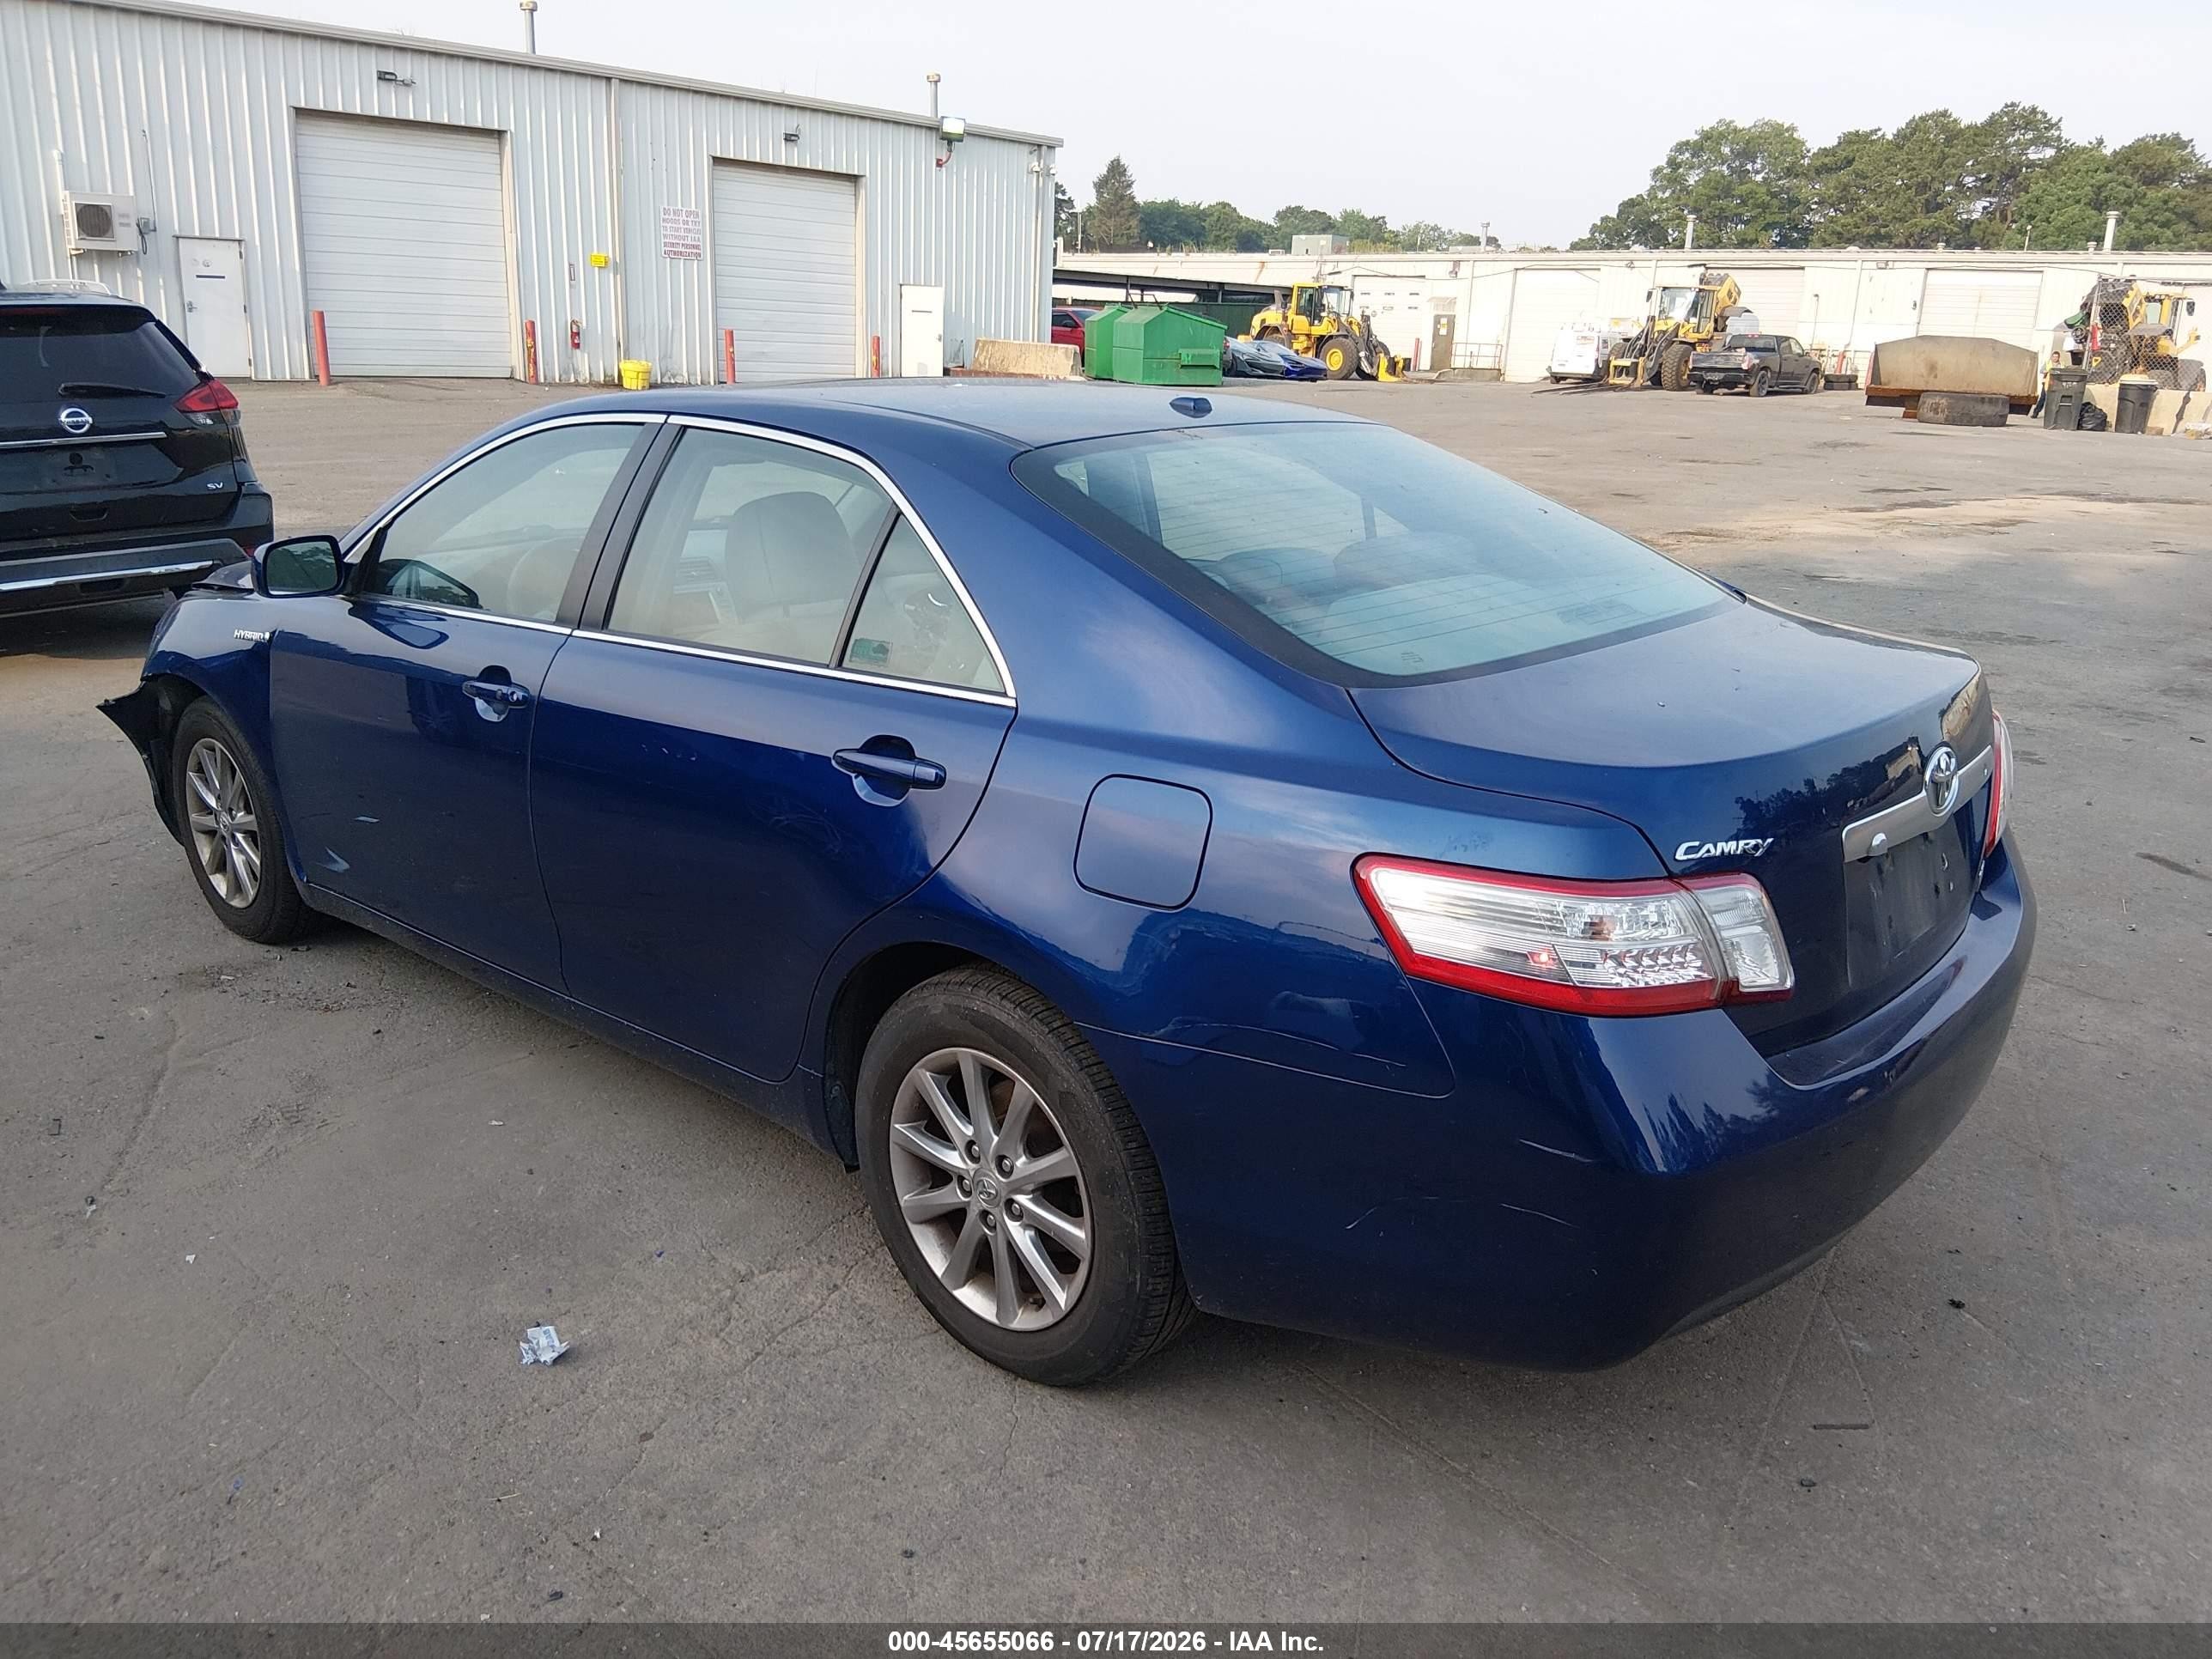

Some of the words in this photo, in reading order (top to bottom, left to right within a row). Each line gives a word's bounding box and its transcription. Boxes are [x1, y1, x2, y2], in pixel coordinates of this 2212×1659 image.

[663, 207, 672, 216] DO
[672, 208, 684, 218] NOT
[685, 210, 700, 220] OPEN
[663, 249, 702, 258] AUTHORIZATION
[234, 629, 264, 641] HYBRID
[1674, 838, 1774, 860] CAMRY
